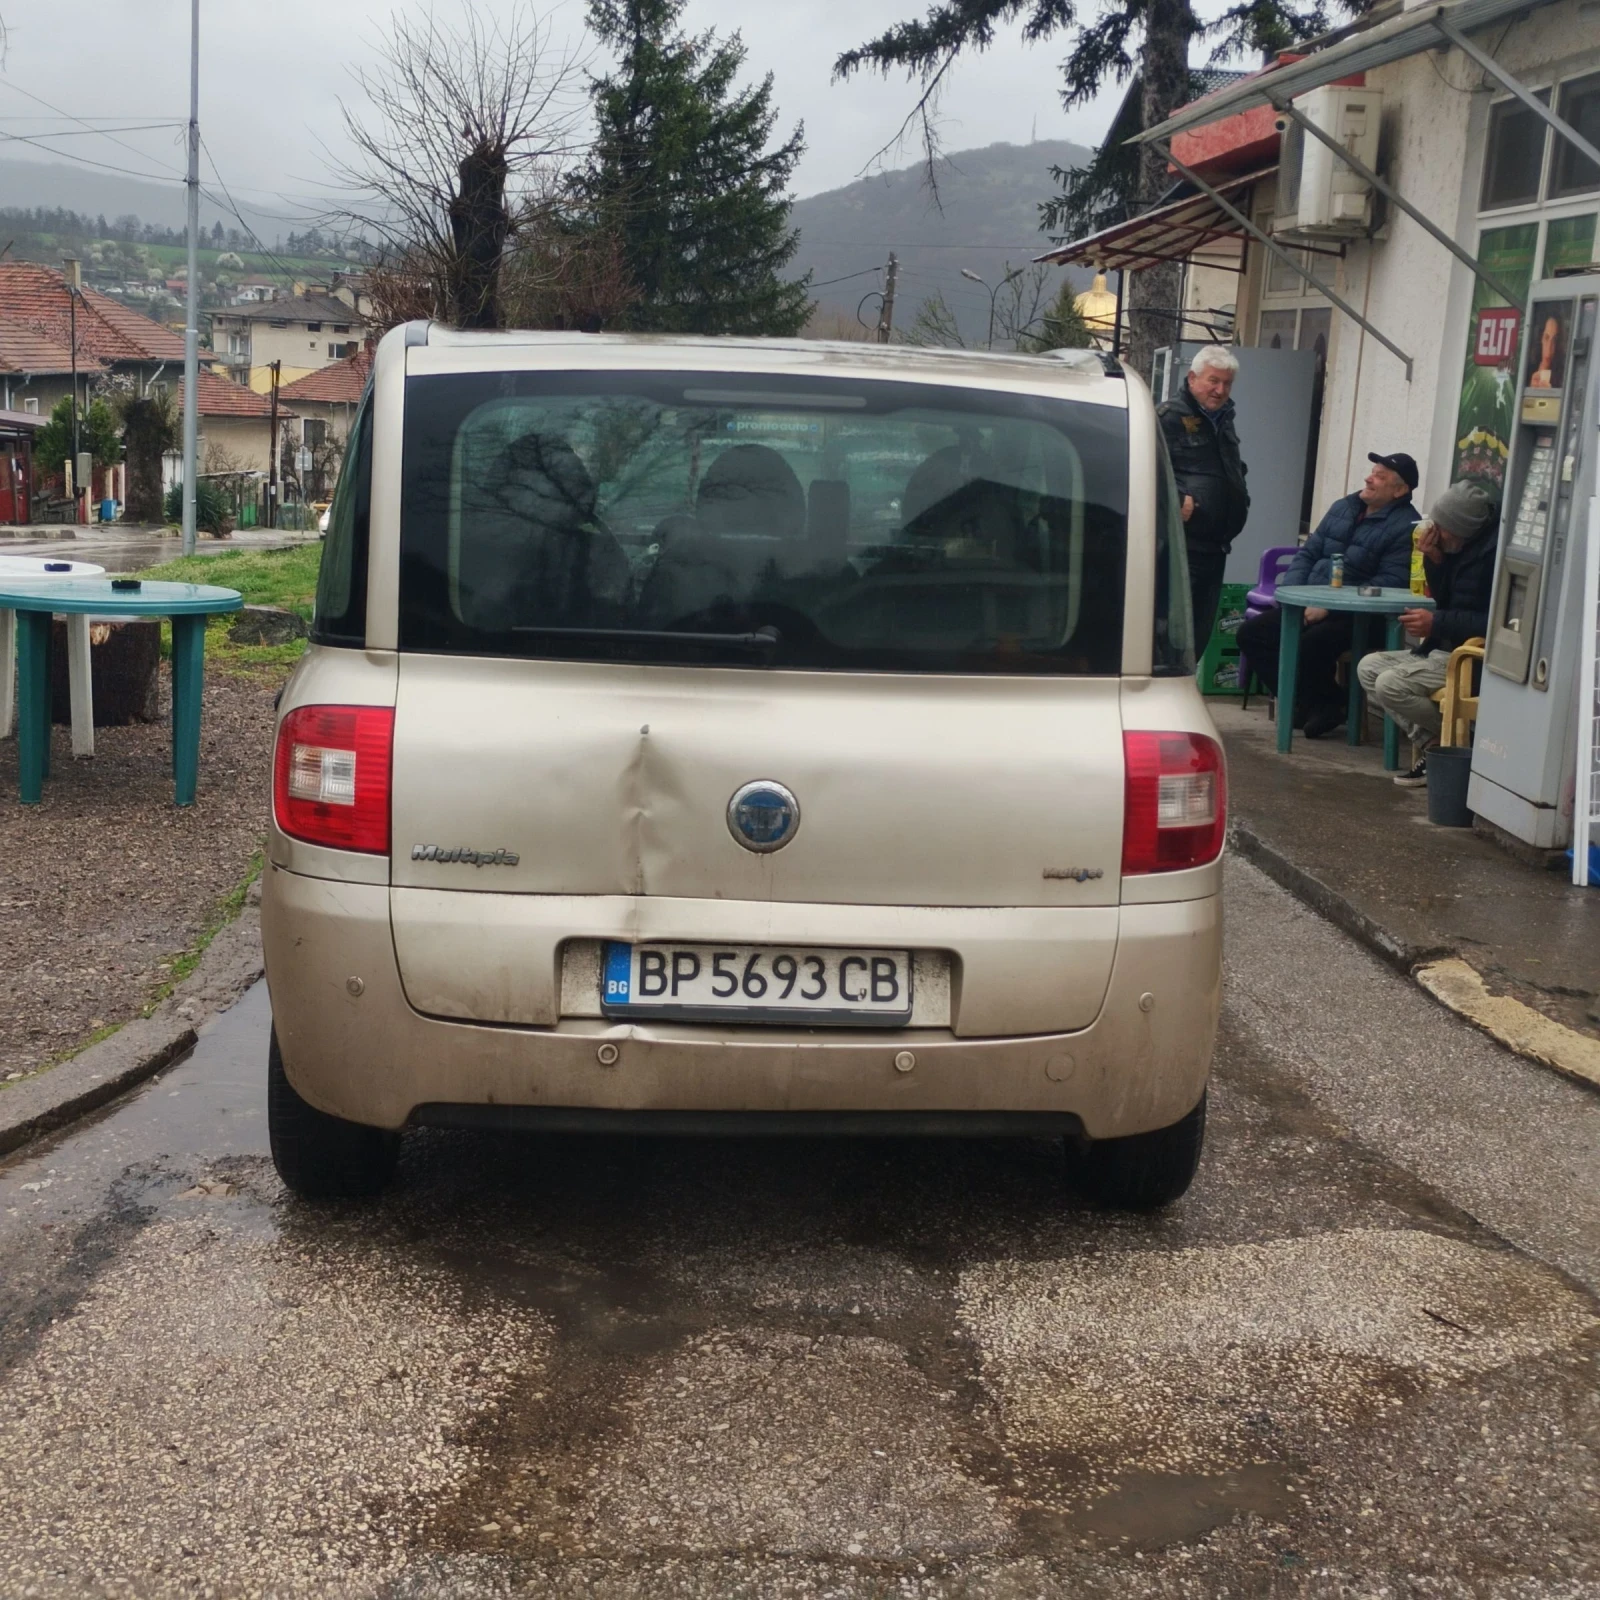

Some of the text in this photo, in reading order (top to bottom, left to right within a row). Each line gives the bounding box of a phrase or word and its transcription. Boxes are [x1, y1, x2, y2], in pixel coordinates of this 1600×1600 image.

[411, 844, 520, 867] Multipla
[607, 979, 628, 994] BG
[638, 950, 899, 1003] BP 5693 CB
